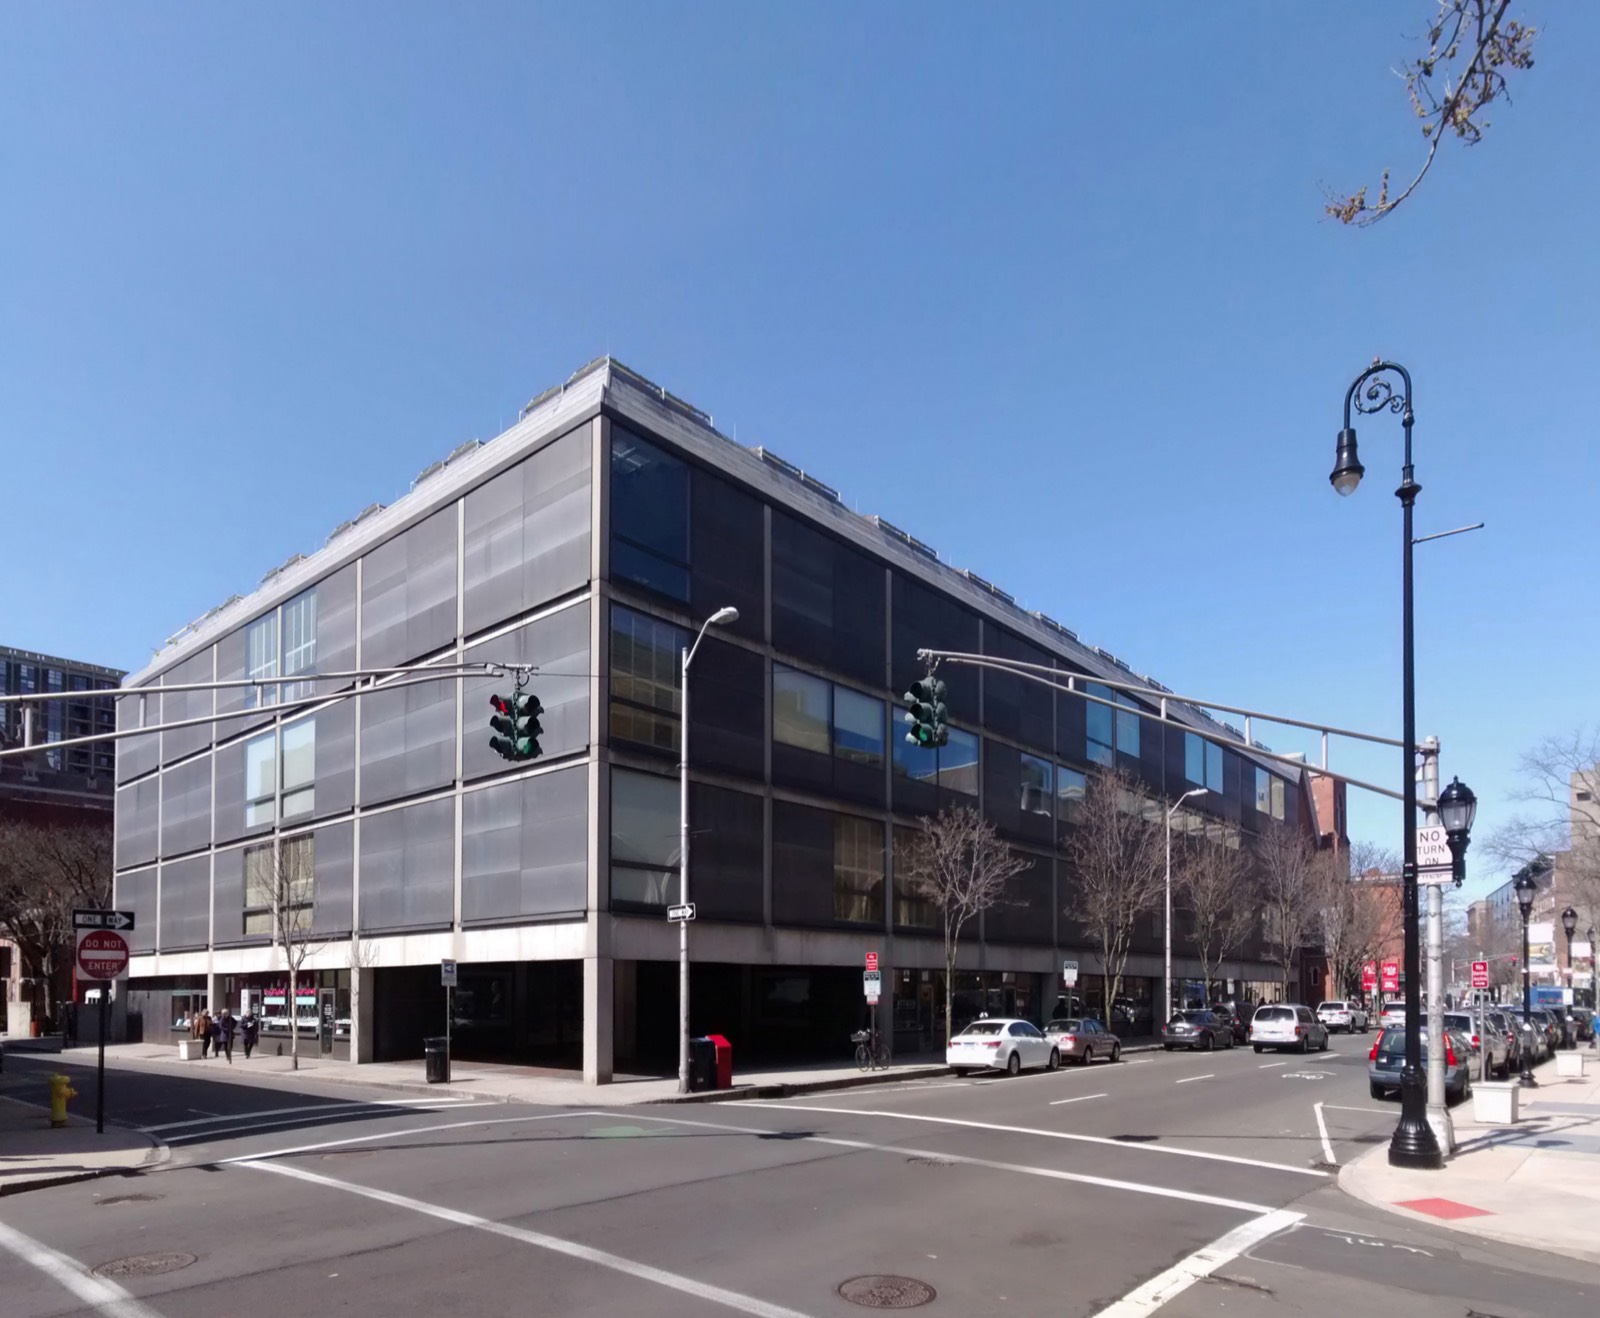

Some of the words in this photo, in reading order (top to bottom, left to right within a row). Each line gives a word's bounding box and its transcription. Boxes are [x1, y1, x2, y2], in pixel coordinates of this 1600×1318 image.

[1419, 830, 1440, 842] NO
[1417, 844, 1445, 855] TURN
[1425, 857, 1439, 866] ON
[82, 914, 98, 923] ONE
[108, 916, 122, 924] WAY
[85, 939, 99, 948] DO
[104, 940, 122, 948] NOT
[88, 961, 118, 970] ENTER
